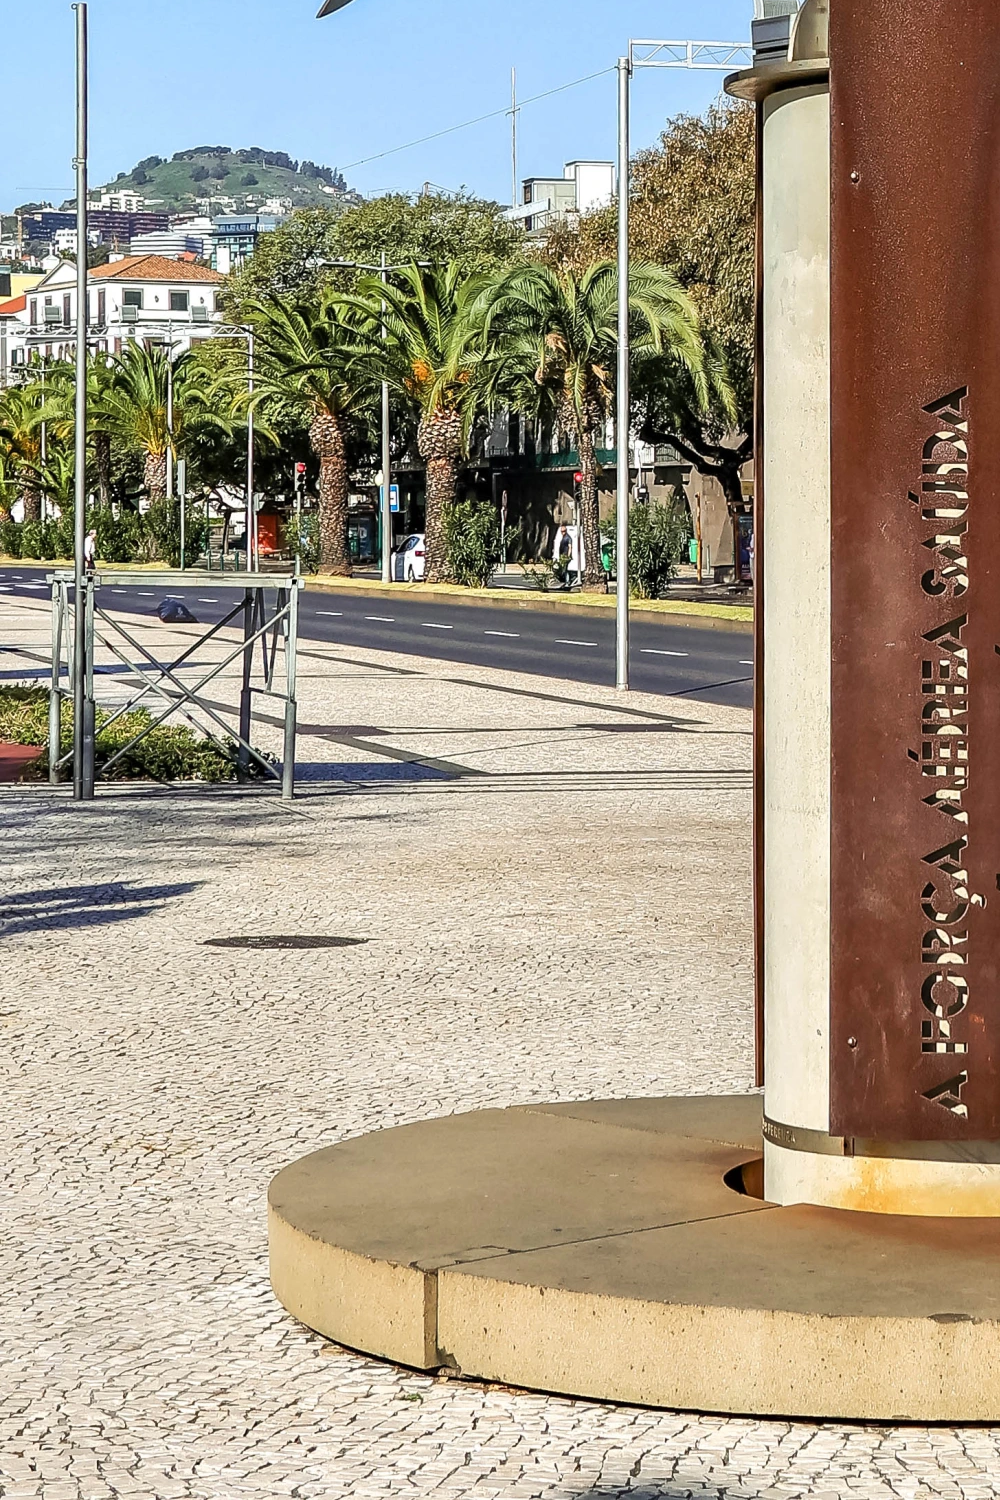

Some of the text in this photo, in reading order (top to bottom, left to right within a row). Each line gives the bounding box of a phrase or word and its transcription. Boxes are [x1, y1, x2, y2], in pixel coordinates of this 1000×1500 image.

[906, 385, 988, 1120] A FORÇA AÉREA SAÚDA
